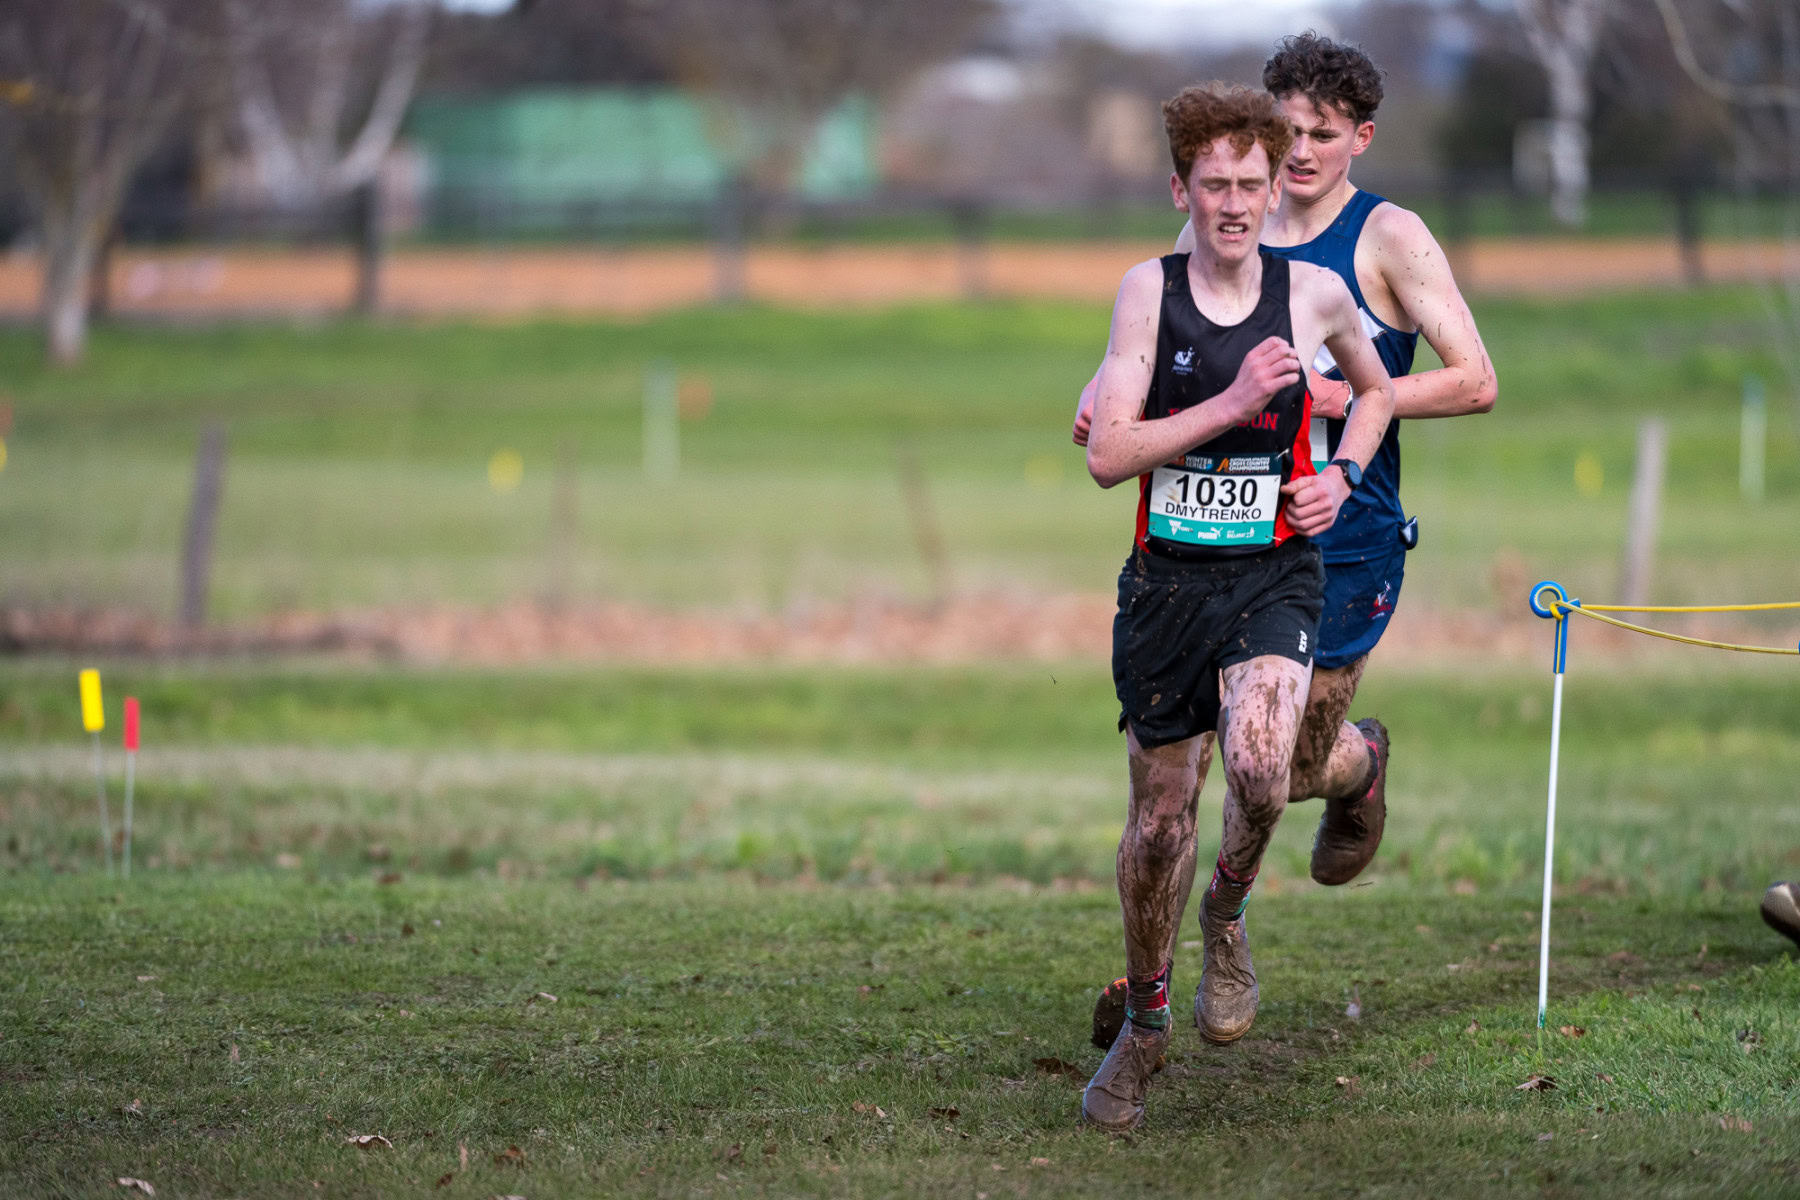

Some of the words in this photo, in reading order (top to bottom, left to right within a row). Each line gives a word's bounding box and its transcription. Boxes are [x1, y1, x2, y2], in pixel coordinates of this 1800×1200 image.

[1185, 456, 1213, 465] WINTER
[1176, 474, 1258, 508] 1030
[1165, 502, 1262, 521] DMYTRENKO
